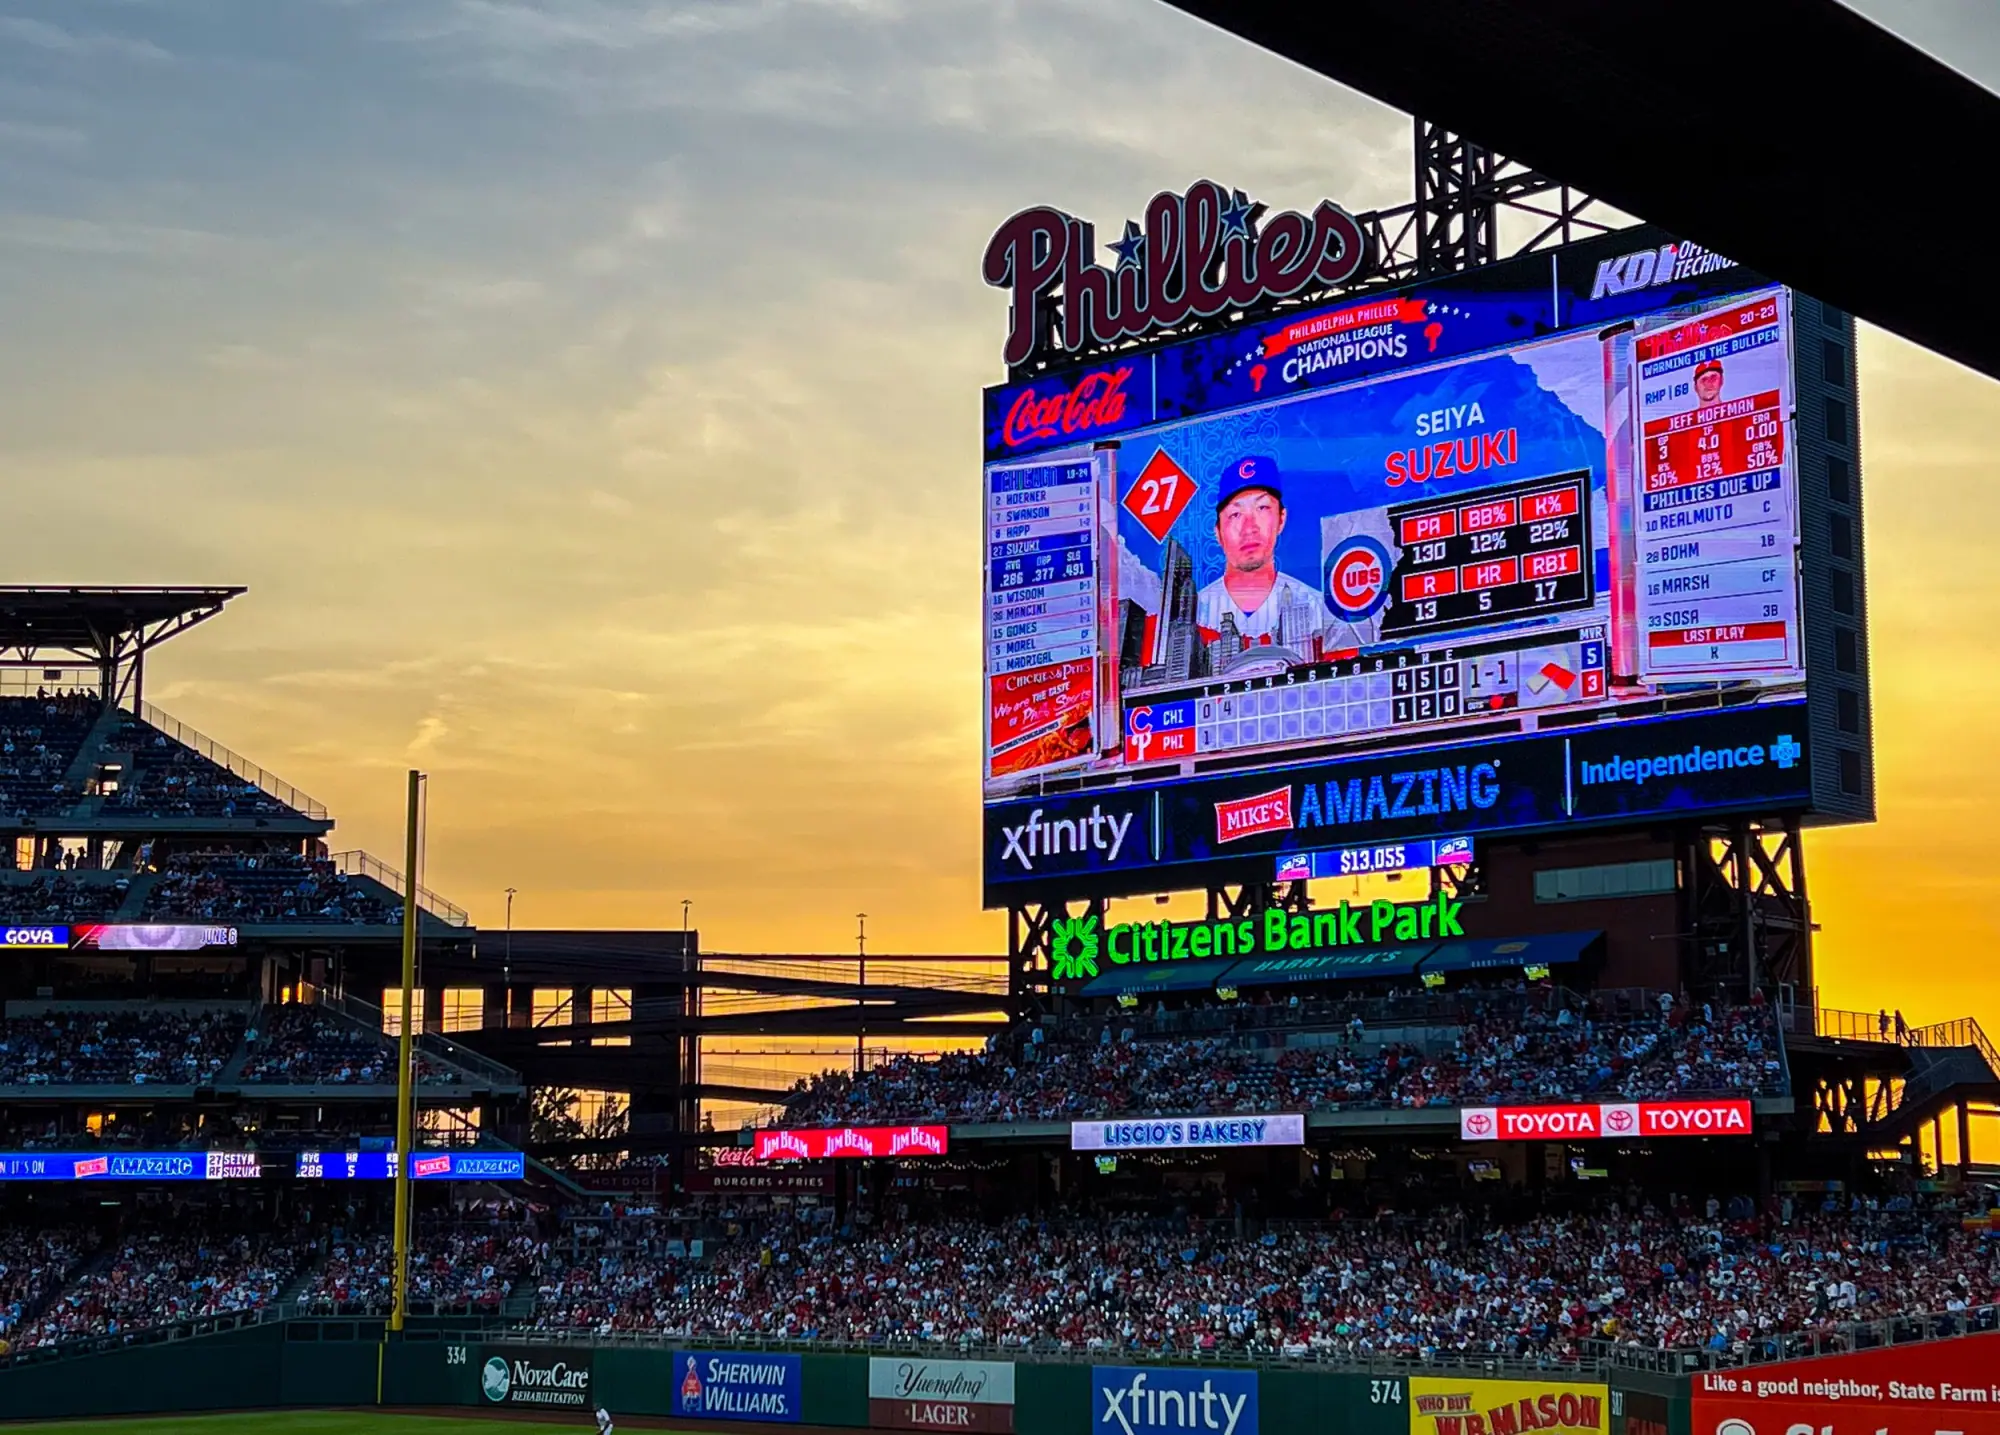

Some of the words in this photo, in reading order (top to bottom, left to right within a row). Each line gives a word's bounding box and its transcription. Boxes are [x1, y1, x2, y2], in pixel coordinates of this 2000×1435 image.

[982, 178, 1370, 367] Phillies
[1288, 314, 1355, 341] PHILADELPHIA
[1357, 303, 1399, 323] PHILLIES
[1740, 305, 1775, 325] 20-23
[1297, 331, 1352, 357] NATIONAL
[1353, 323, 1393, 340] LEAGUE
[1644, 354, 1691, 376] WARMING
[1694, 349, 1706, 362] IN
[1710, 342, 1729, 358] THE
[1732, 327, 1779, 351] BULLPEN
[1282, 333, 1408, 383] CHAMPIONS
[1003, 366, 1134, 447] Coca-Cola
[1645, 388, 1666, 405] RHP
[1674, 383, 1689, 396] 68
[1415, 402, 1485, 437] SEIYA
[1668, 413, 1693, 430] JEFF
[1697, 399, 1755, 423] HOFFMAN
[1752, 412, 1771, 425] ERA
[1659, 446, 1668, 460] 3
[1697, 434, 1719, 451] 4.0
[1745, 421, 1777, 441] 0.00
[1384, 427, 1518, 488] SUZUKI
[1650, 471, 1678, 488] 50%
[1696, 461, 1723, 479] 12%
[1747, 449, 1778, 469] 50%
[1006, 490, 1046, 505] HOERNER
[1140, 474, 1179, 516] 27
[1650, 483, 1715, 510] PHILLIES
[1719, 476, 1748, 497] DUE
[1752, 472, 1772, 489] UP
[1006, 506, 1050, 522] SWANSON
[1416, 516, 1441, 538] PA
[1468, 506, 1507, 529] BB%
[1535, 494, 1562, 515] K%
[1646, 519, 1658, 532] 10
[1660, 503, 1733, 530] REALMUTO
[1763, 500, 1771, 513] C
[1006, 524, 1030, 538] HAPP
[1412, 547, 1446, 565] 130
[1470, 531, 1507, 554] 12%
[1529, 519, 1569, 544] 22%
[993, 545, 1004, 556] 27
[1006, 539, 1040, 555] SUZUKI
[1646, 550, 1659, 564] 28
[1661, 541, 1700, 561] BOHM
[1760, 534, 1775, 548] 1B
[1032, 567, 1055, 582] .377
[1062, 562, 1085, 578] .491
[1424, 575, 1436, 593] R
[1476, 564, 1501, 585] HR
[1533, 554, 1568, 576] RBI
[1648, 583, 1659, 596] 16
[1662, 574, 1710, 594] MARSH
[1762, 569, 1777, 583] CF
[1006, 587, 1045, 604] WISDOM
[1414, 600, 1437, 622] 13
[1479, 591, 1492, 611] 5
[1534, 581, 1558, 601] 17
[1006, 602, 1048, 620] MANCINI
[1648, 615, 1662, 627] 33
[1663, 609, 1700, 627] SOSA
[1763, 604, 1778, 617] 3B
[1006, 621, 1037, 638] GOMES
[1579, 627, 1603, 641] MVR
[1683, 628, 1712, 643] LAST
[1715, 626, 1745, 640] PLAY
[1006, 639, 1036, 655] MOREL
[1586, 647, 1597, 664] 5
[1006, 651, 1053, 671] MADRIGAL
[1471, 660, 1509, 689] 1-1
[1223, 683, 1231, 694] 2
[1287, 673, 1295, 685] 5
[1330, 666, 1338, 679] 7
[1587, 674, 1598, 692] 3
[1032, 689, 1047, 704] THE
[1129, 705, 1153, 735] C
[1163, 709, 1184, 726] CHI
[1223, 701, 1232, 715] 4
[1397, 675, 1407, 691] 4
[1420, 672, 1430, 688] 5
[1444, 669, 1453, 685] 0
[1162, 733, 1184, 751] PHI
[1399, 703, 1407, 719] 1
[1420, 699, 1430, 715] 2
[1444, 696, 1454, 713] 0
[1581, 744, 1764, 785] Independence
[1226, 800, 1284, 831] MIKE'S
[1298, 763, 1500, 829] AMAZING
[1001, 804, 1133, 871] xfinity
[1340, 846, 1406, 873] $13,055
[5, 929, 54, 944] GOYA
[200, 926, 227, 945] JUNE
[228, 927, 238, 945] 6
[1106, 918, 1255, 965] Citizens
[1264, 900, 1363, 952] Bank
[1371, 892, 1464, 943] Park
[1252, 955, 1334, 972] HARRY
[1359, 950, 1402, 964] K'S
[1104, 1123, 1183, 1146] LISCIO'S
[1187, 1119, 1268, 1143] BAKERY
[1503, 1112, 1594, 1133] TOYOTA
[1646, 1108, 1744, 1130] TOYOTA
[760, 1136, 780, 1158] JIM
[780, 1130, 809, 1157] BEAM
[822, 1134, 844, 1156] JIM
[844, 1128, 873, 1156] BEAM
[889, 1133, 910, 1155] JIM
[910, 1126, 941, 1154] BEAM
[110, 1156, 193, 1176] AMAZING
[208, 1154, 221, 1166] 27
[223, 1153, 255, 1166] SEIYA
[302, 1152, 320, 1163] AVG
[346, 1152, 358, 1163] HR
[347, 1165, 356, 1177] 5
[456, 1160, 521, 1174] AMAZING
[208, 1166, 221, 1178] RF
[223, 1166, 262, 1178] SUZUKI
[713, 1177, 772, 1187] BURGERS
[788, 1177, 824, 1187] FRIES
[447, 1346, 466, 1365] 334
[512, 1361, 589, 1389] NovaCare
[706, 1357, 786, 1387] SHERWIN
[894, 1362, 987, 1400] Yuengling
[512, 1391, 586, 1405] REHABILITATION
[1370, 1379, 1402, 1404] 374
[1703, 1374, 1737, 1392] Like
[1742, 1379, 1751, 1392] a
[1757, 1378, 1798, 1397] good
[1803, 1379, 1883, 1400] neighbor,
[1888, 1381, 1935, 1400] State
[1940, 1383, 1988, 1402] Farm
[911, 1403, 969, 1426] LAGER
[1102, 1373, 1247, 1435] xfinity
[1415, 1395, 1444, 1413] WHO
[1447, 1394, 1472, 1411] BUT
[1488, 1392, 1602, 1435] MASON
